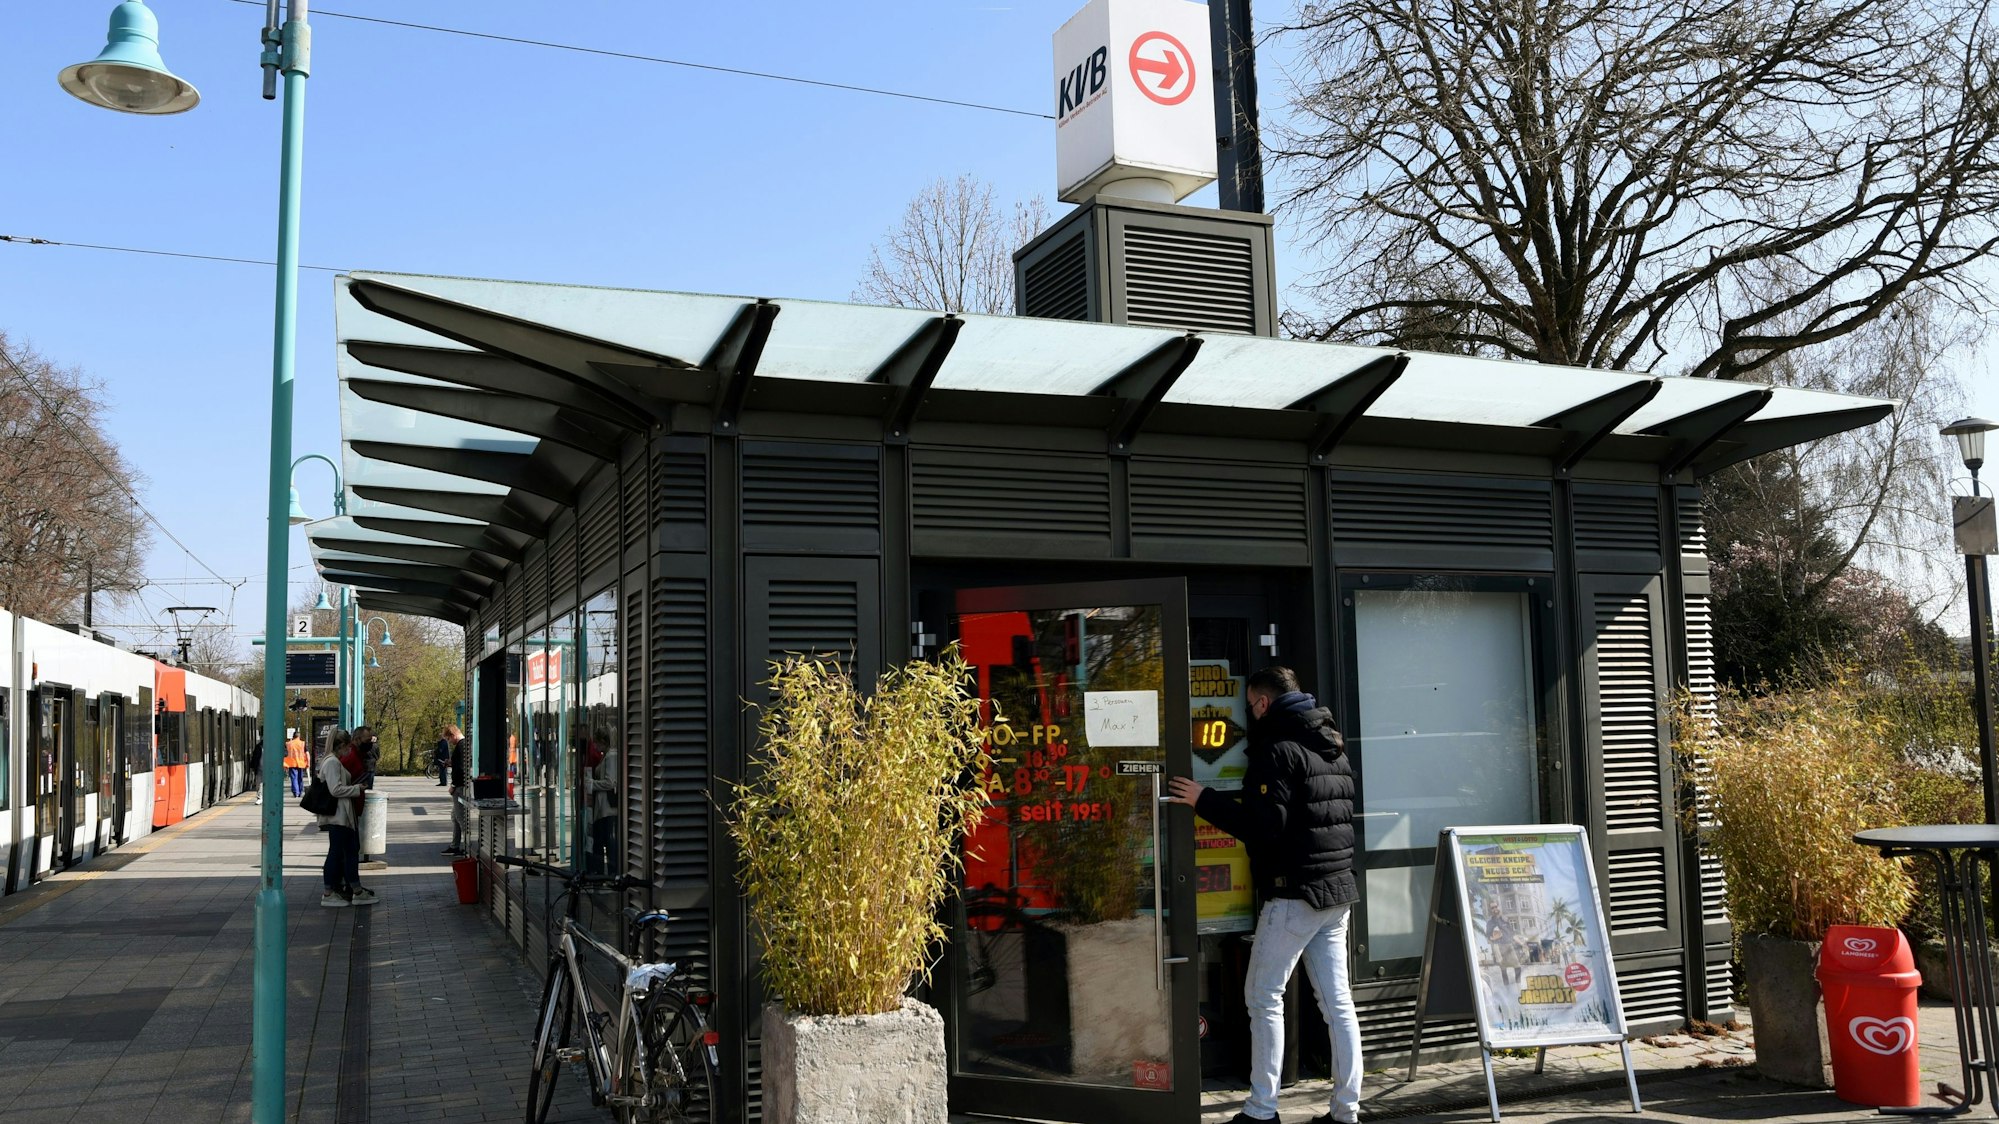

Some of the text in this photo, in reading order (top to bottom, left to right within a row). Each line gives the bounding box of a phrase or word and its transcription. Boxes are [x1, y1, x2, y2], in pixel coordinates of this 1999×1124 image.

[1059, 45, 1107, 120] KVB
[299, 621, 307, 632] 2
[1191, 680, 1236, 697] CKPOT
[1101, 718, 1127, 732] Max
[1202, 721, 1226, 746] 10
[1122, 764, 1160, 773] ZIEHEN
[1021, 801, 1112, 821] seit 1951
[1469, 856, 1501, 865] GLEICHE
[1485, 867, 1510, 876] NEUES
[1526, 975, 1561, 991] EURO
[1518, 988, 1572, 1005] JACKPOT
